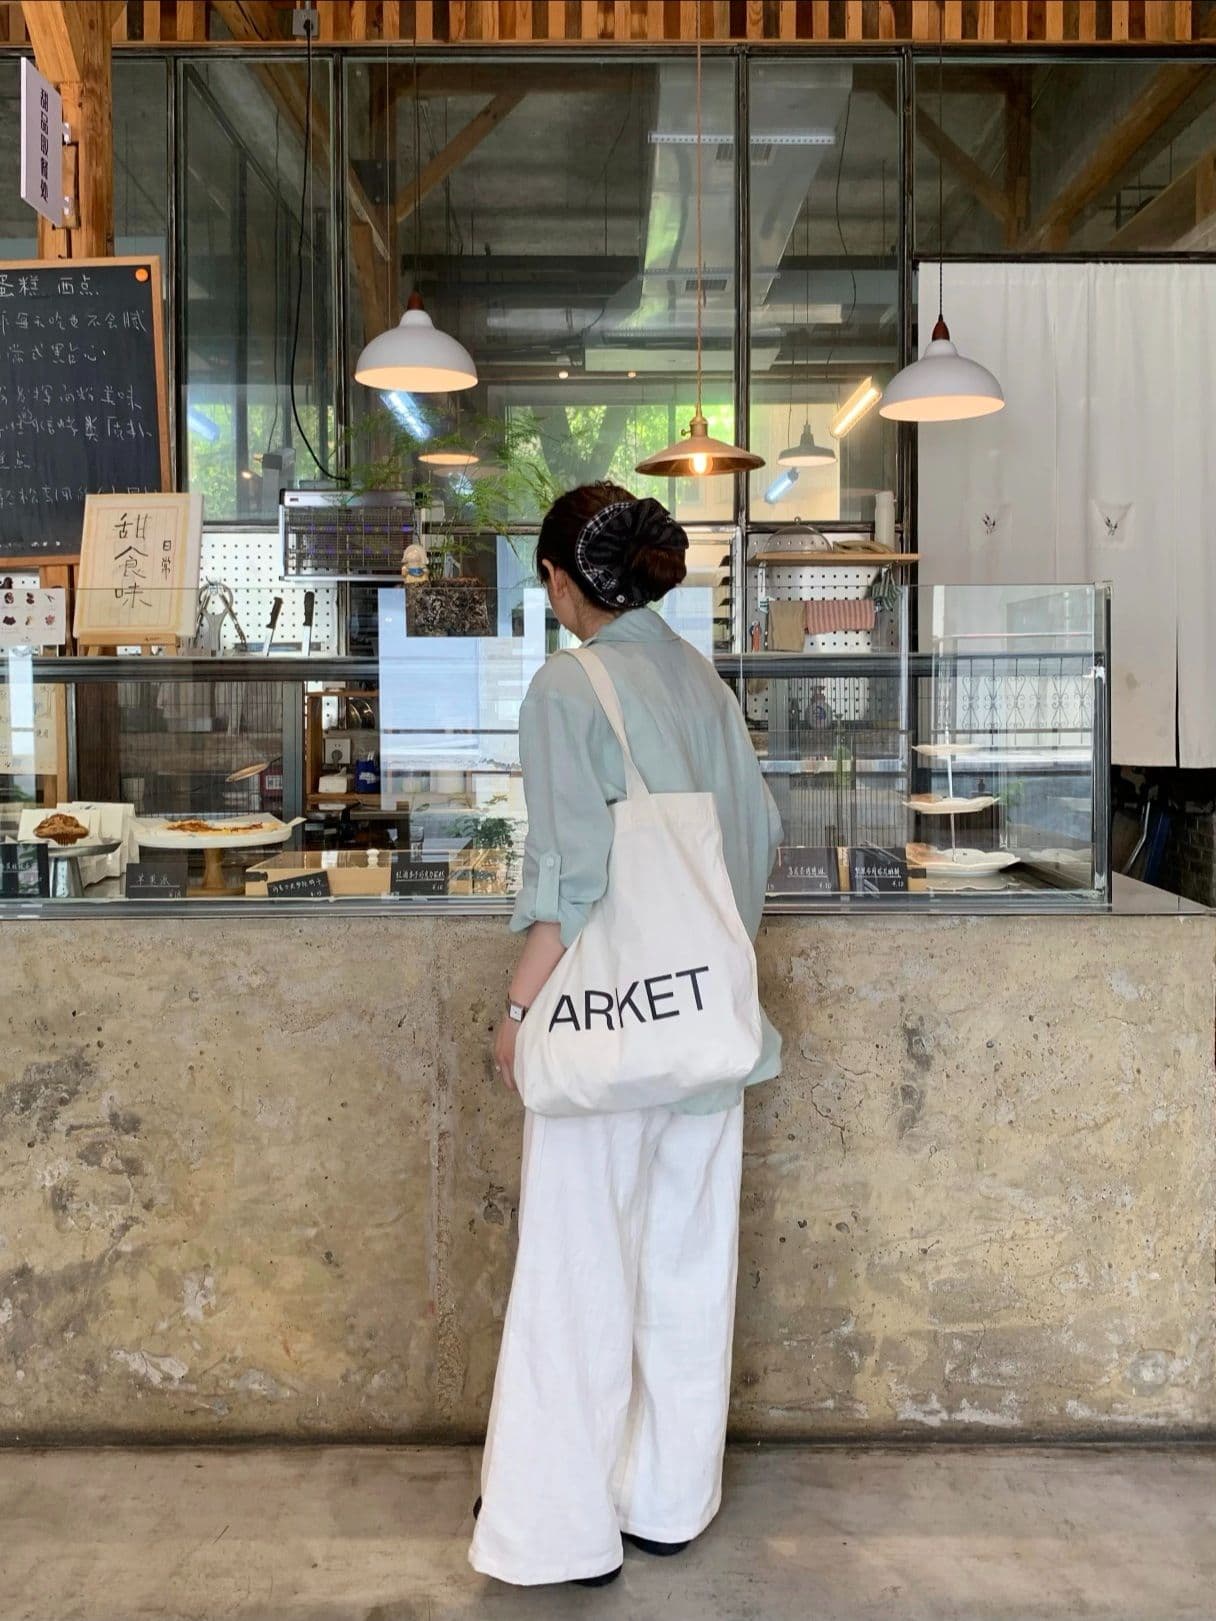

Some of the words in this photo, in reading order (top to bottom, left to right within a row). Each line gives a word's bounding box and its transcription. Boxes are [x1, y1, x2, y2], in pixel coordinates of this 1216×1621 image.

[40, 87, 49, 202] 甜品取餐处
[57, 274, 100, 296] 西点
[0, 342, 106, 365] 常式點心
[113, 512, 153, 609] 甜食味
[161, 539, 172, 581] 日常
[548, 966, 710, 1033] ARKET
